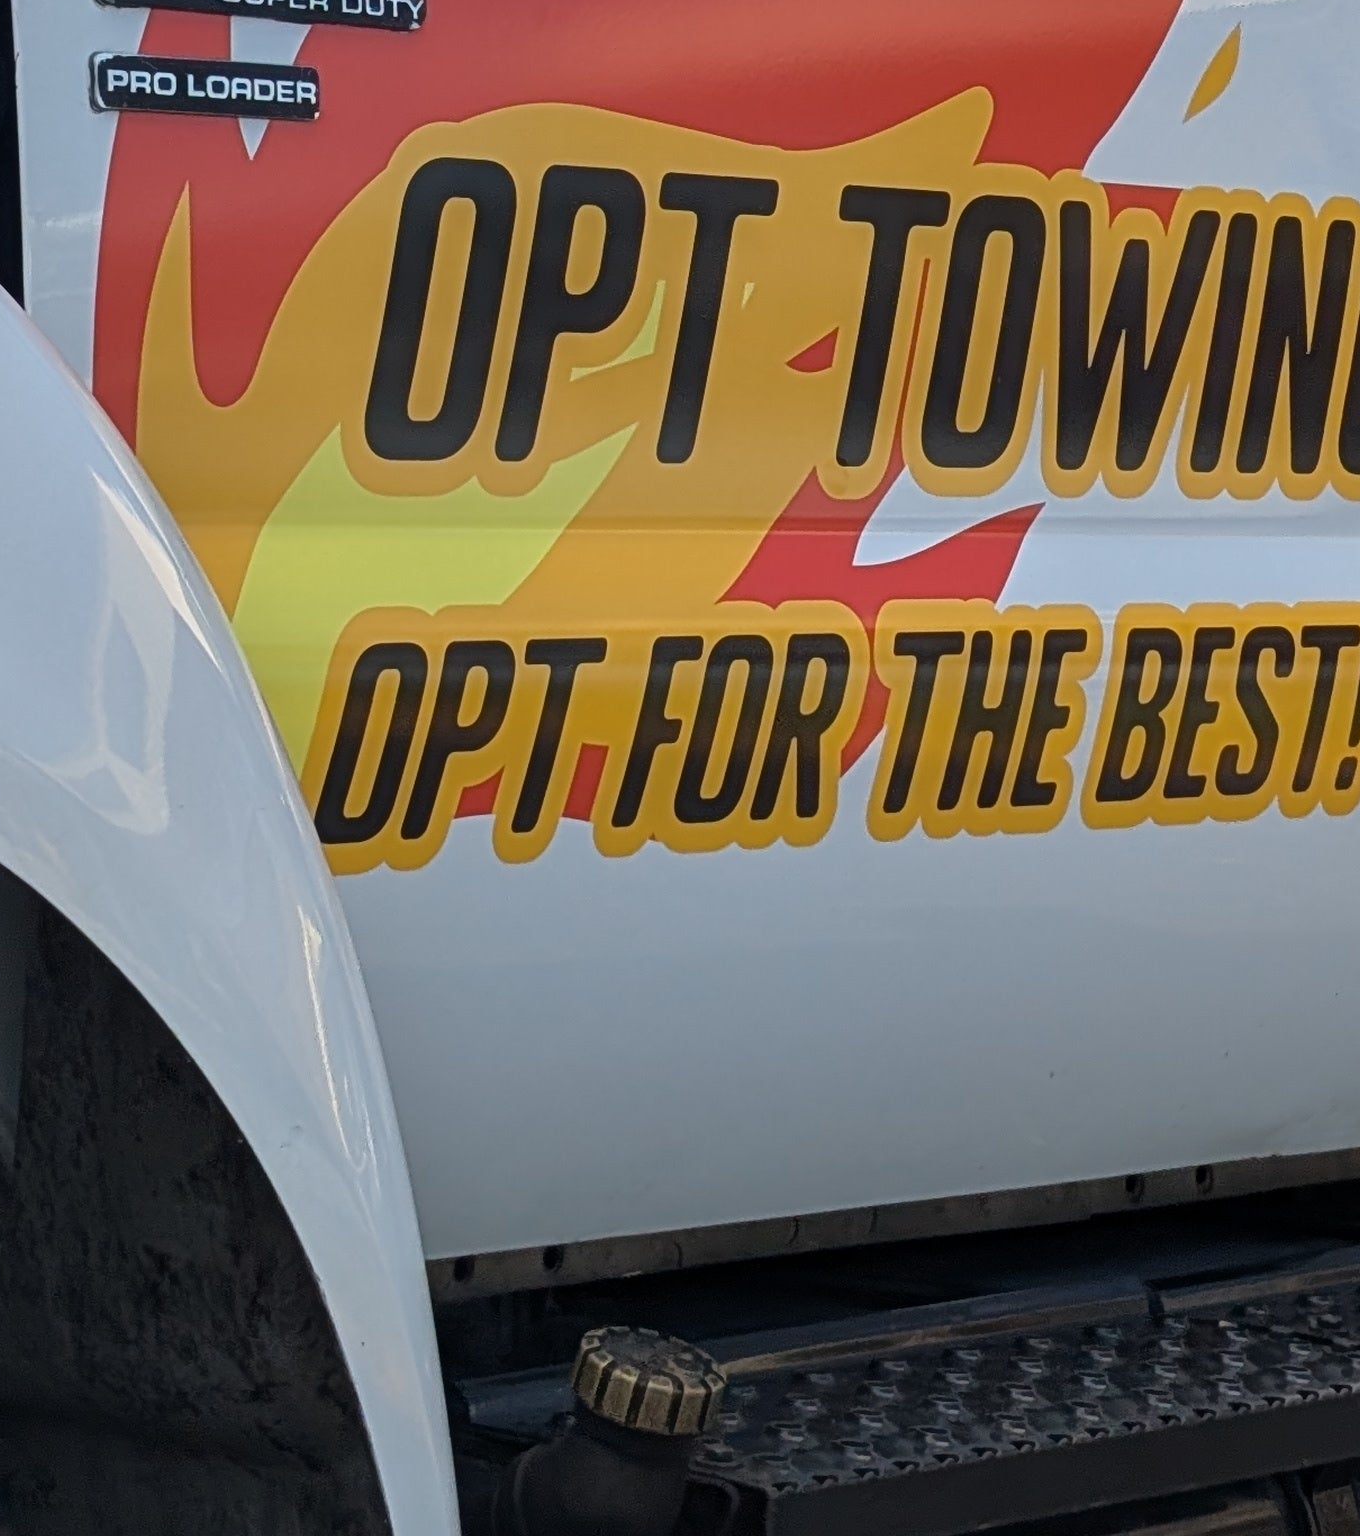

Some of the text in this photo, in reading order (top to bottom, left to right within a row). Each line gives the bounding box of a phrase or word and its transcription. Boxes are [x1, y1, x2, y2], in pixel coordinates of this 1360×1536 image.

[106, 69, 317, 105] PRO LOADER
[364, 156, 778, 464] OPT
[314, 637, 608, 845] OPT
[611, 633, 851, 828] FOR
[882, 629, 1088, 814] THE
